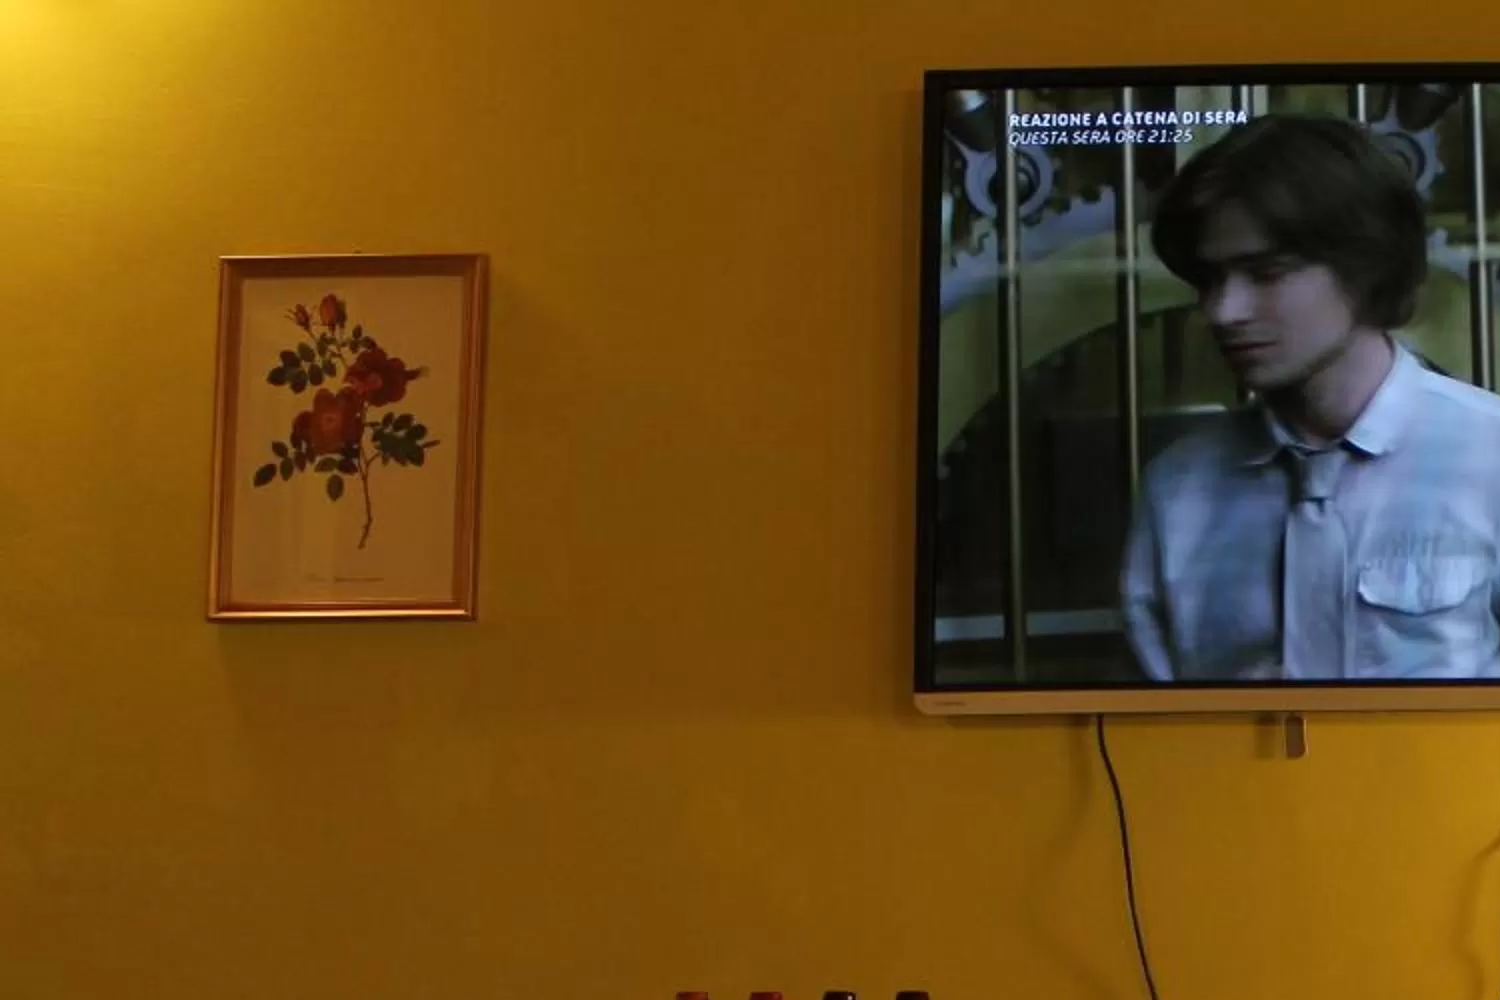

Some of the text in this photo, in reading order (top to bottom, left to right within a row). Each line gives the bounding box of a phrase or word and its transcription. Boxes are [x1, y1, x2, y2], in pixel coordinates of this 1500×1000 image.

[1009, 110, 1248, 127] REAZIONE A CATENA DI SERA
[1009, 128, 1193, 146] QUESTA SERA ORE 21:25
